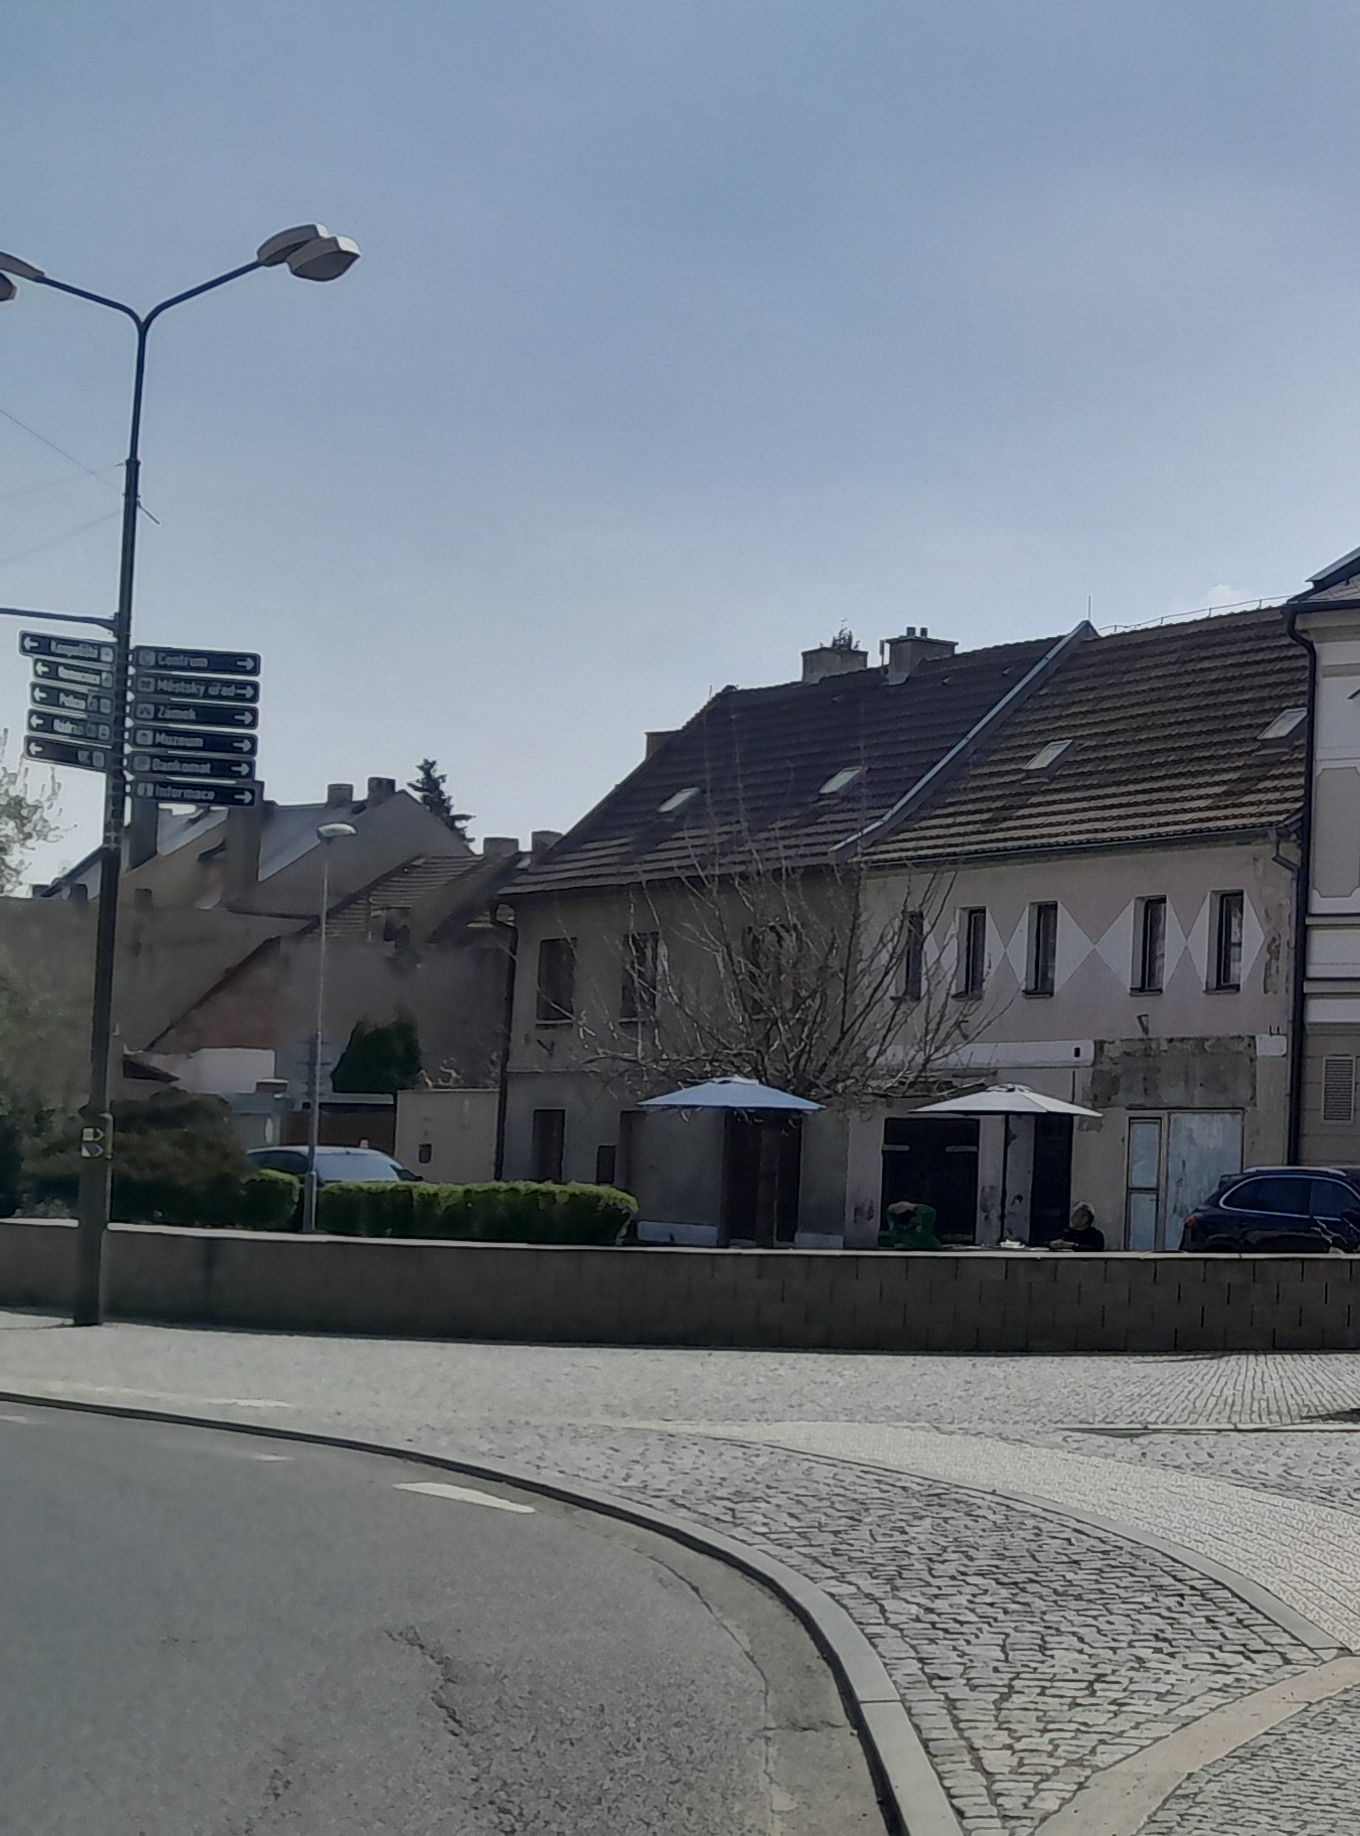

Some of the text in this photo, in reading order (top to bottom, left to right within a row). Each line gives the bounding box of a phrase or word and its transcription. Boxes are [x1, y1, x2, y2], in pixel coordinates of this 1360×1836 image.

[158, 652, 208, 667] Centrum
[155, 732, 204, 748] Muzeum
[155, 783, 215, 800] Informace
